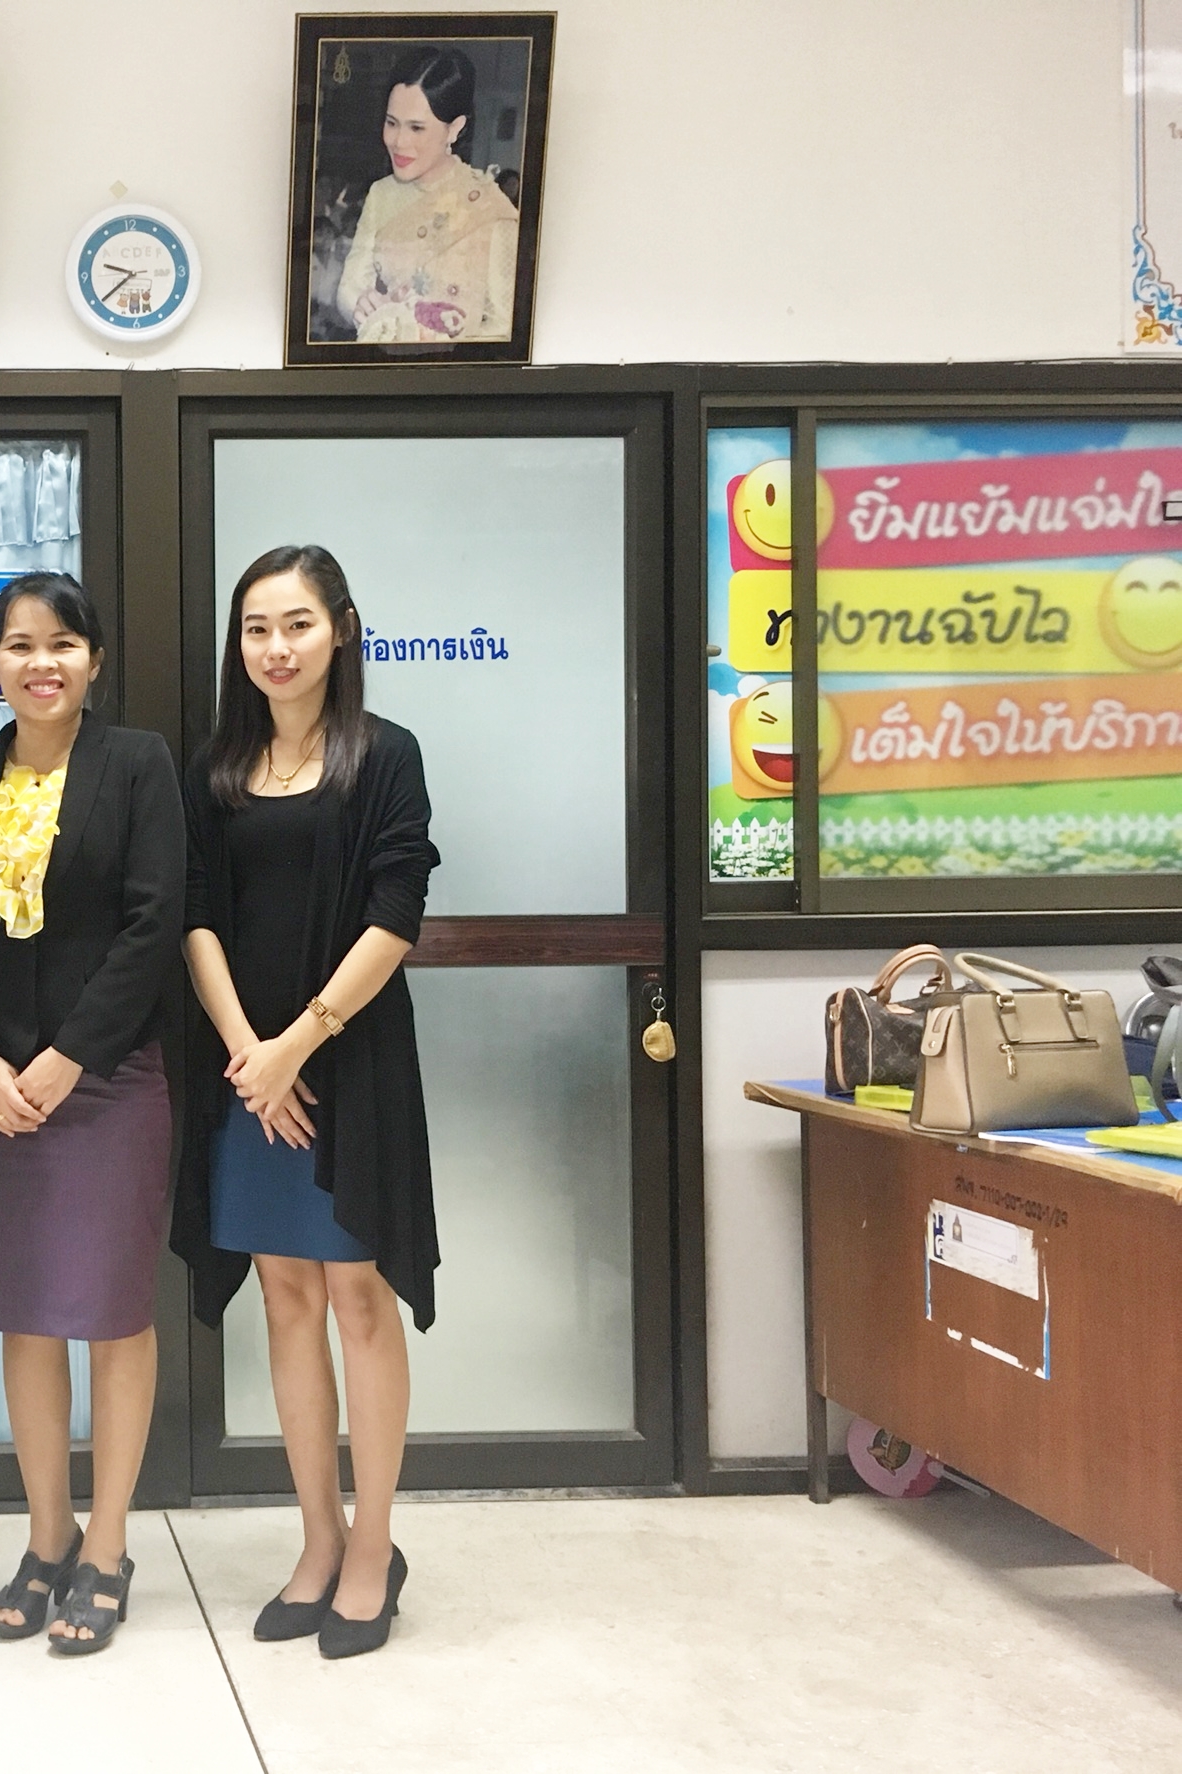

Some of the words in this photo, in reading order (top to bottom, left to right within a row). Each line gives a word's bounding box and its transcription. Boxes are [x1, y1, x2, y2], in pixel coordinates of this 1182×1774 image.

[124, 219, 137, 231] 12
[81, 271, 89, 283] 9
[178, 265, 187, 278] 3
[132, 317, 141, 329] 6
[851, 698, 1182, 764] เต็มใจให้บริกา
